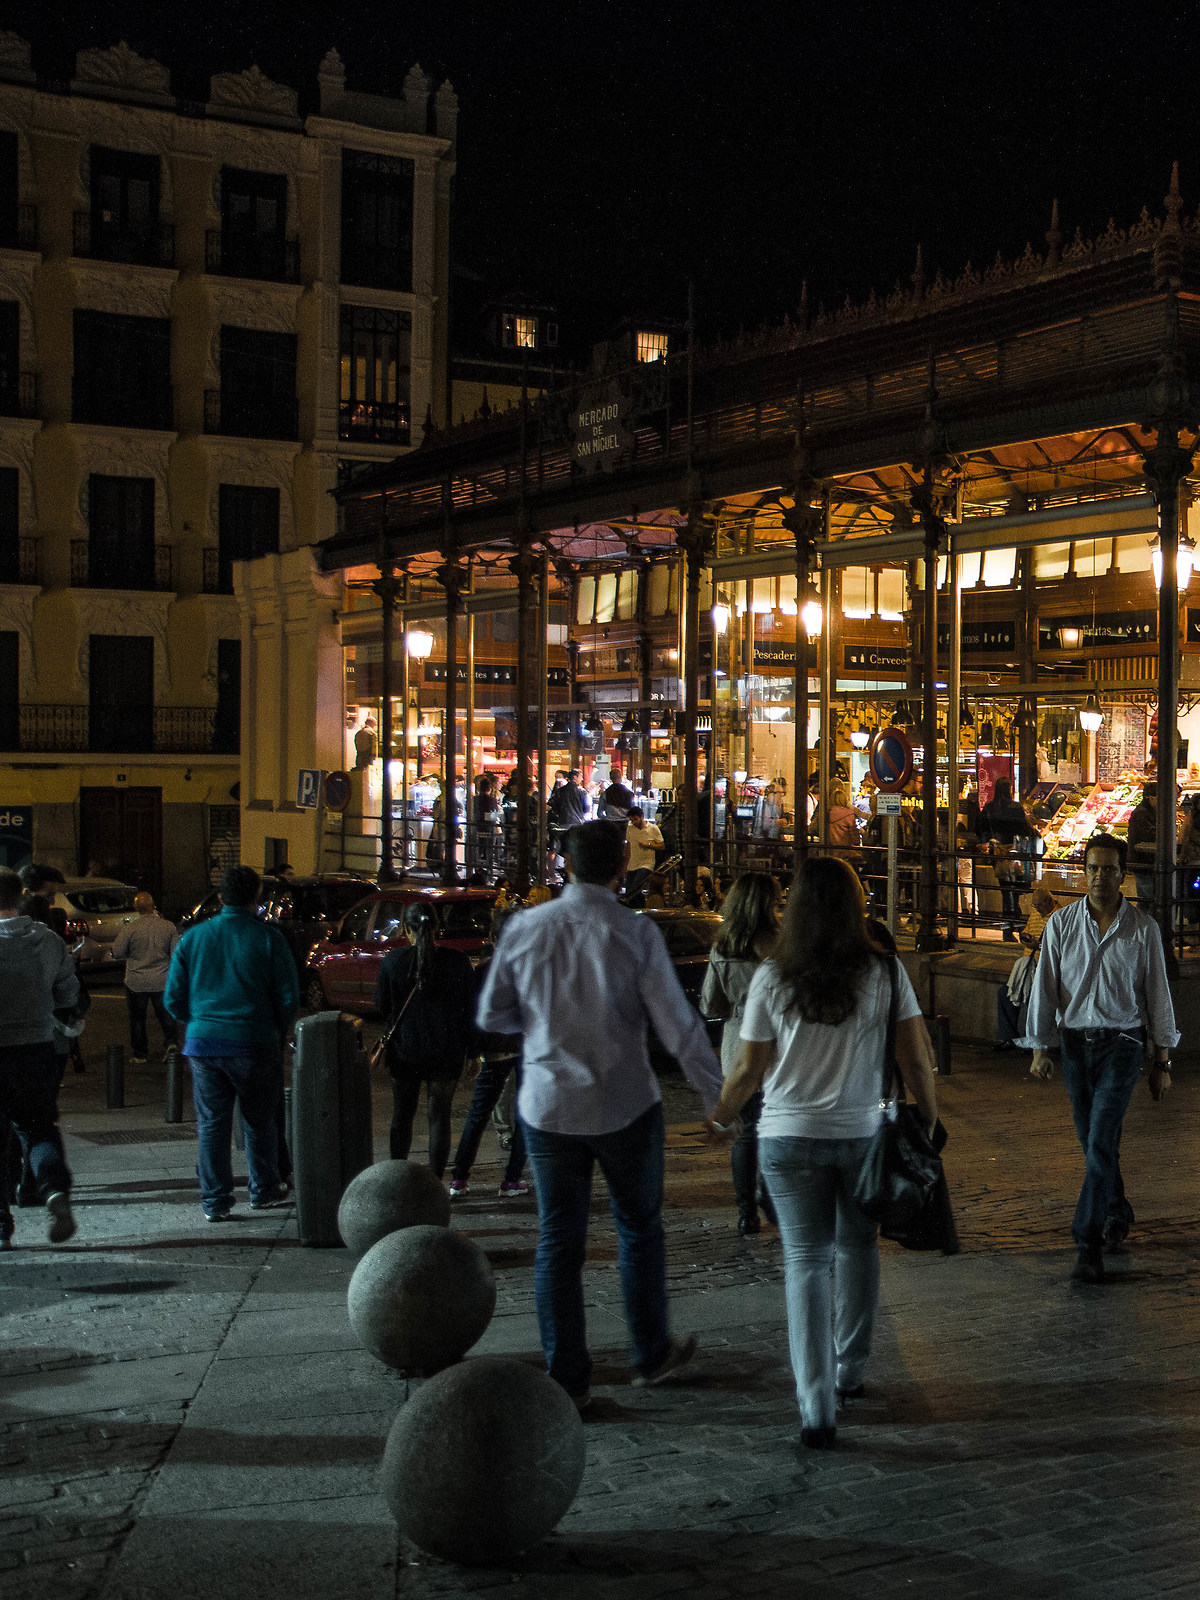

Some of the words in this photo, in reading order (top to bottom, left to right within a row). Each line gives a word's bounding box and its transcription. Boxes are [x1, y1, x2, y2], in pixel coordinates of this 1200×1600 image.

[578, 404, 619, 428] MERCADO
[592, 424, 604, 437] DE
[577, 438, 592, 458] SAN
[592, 434, 620, 455] MIGUEL
[1082, 624, 1112, 637] Frutas
[456, 669, 488, 679] Actes
[302, 772, 313, 804] P
